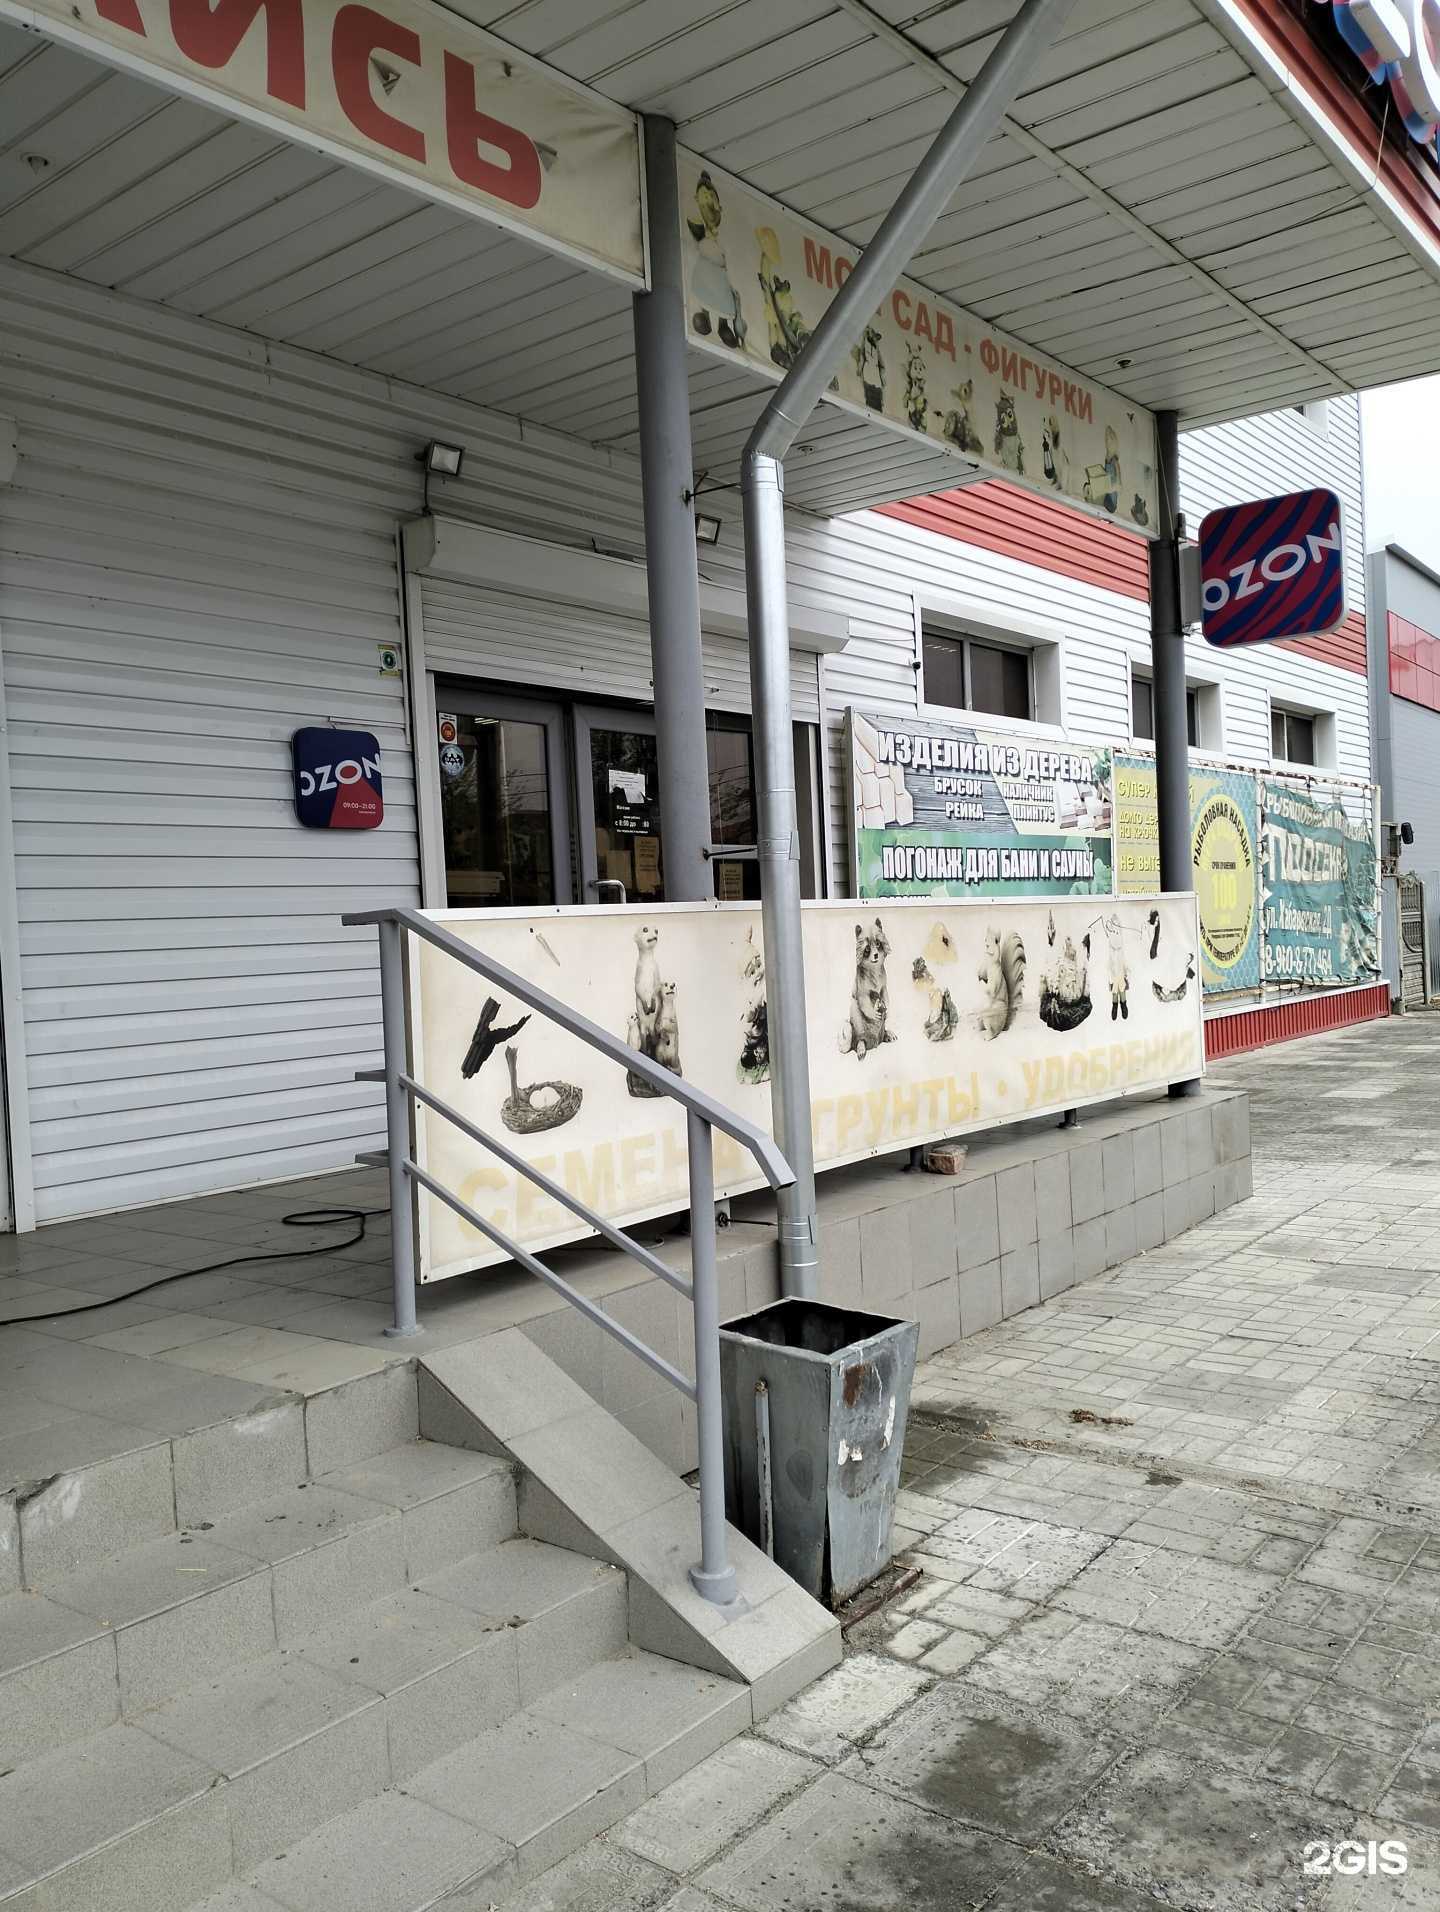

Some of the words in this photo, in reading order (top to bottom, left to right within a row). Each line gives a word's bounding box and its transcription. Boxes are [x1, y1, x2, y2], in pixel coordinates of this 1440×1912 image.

[95, 0, 541, 209] ИСЬ
[891, 289, 957, 362] САД
[980, 338, 1095, 424] ФИГУРКИ
[1202, 522, 1342, 611] OZON
[300, 752, 382, 796] OZON
[878, 731, 990, 774] ИЗДЕЛИЯ
[992, 745, 1021, 776] ИЗ
[1023, 750, 1094, 783] ДЕРЕВА
[934, 777, 983, 797] БРУСОК
[945, 801, 984, 820] РЕЙКА
[1013, 804, 1055, 822] ПЛИНТУС
[882, 845, 963, 881] ПОГОНАЖ
[964, 847, 998, 885] ДЛЯ
[1001, 848, 1038, 880] БАНИ
[1040, 849, 1049, 879] И
[1052, 849, 1094, 880] САУНЫ
[811, 1072, 983, 1147] ГРУНТЫ
[1022, 1031, 1195, 1109] УДОБРЕНИЯ
